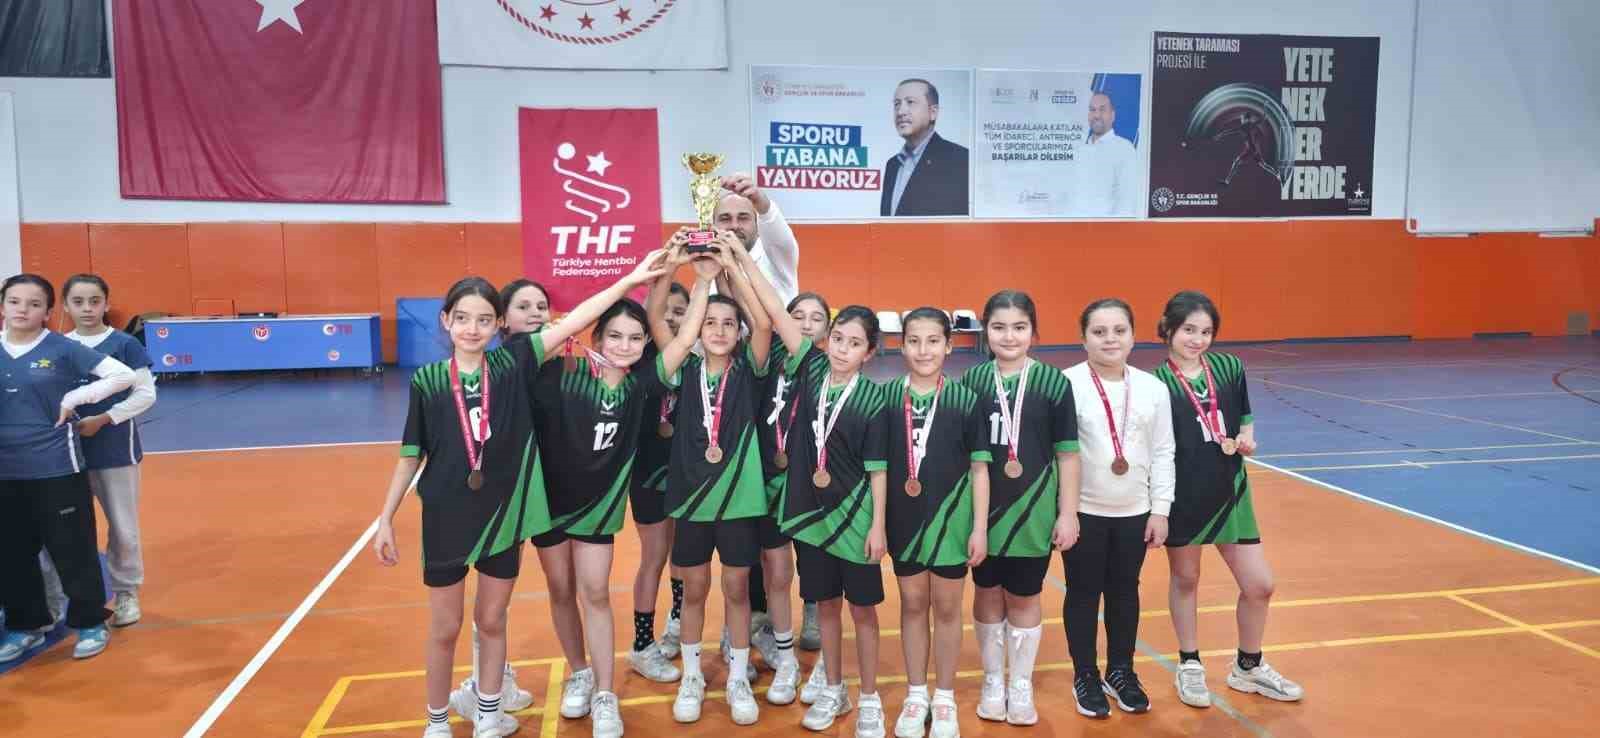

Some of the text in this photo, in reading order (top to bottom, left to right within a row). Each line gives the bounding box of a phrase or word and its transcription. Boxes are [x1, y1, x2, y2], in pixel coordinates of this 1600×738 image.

[1157, 36, 1240, 53] YETENEK TARAMASI
[1156, 53, 1208, 69] PROJESİ İLE
[1283, 47, 1335, 82] YETE
[1281, 87, 1327, 121] NEK
[778, 124, 850, 146] SPORU
[984, 131, 1002, 141] TÜM
[1051, 122, 1083, 132] KATILAN
[771, 147, 860, 167] TABANA
[991, 151, 1074, 163] BAŞARILAR DİLERİM
[759, 168, 878, 189] YAYIYORUZ
[1279, 165, 1347, 200] YERDE
[551, 225, 636, 255] THF
[552, 256, 637, 268] Türkiye Hentbol
[552, 267, 621, 277] Federasyonu
[593, 422, 619, 451] 12
[989, 412, 1009, 446] 11
